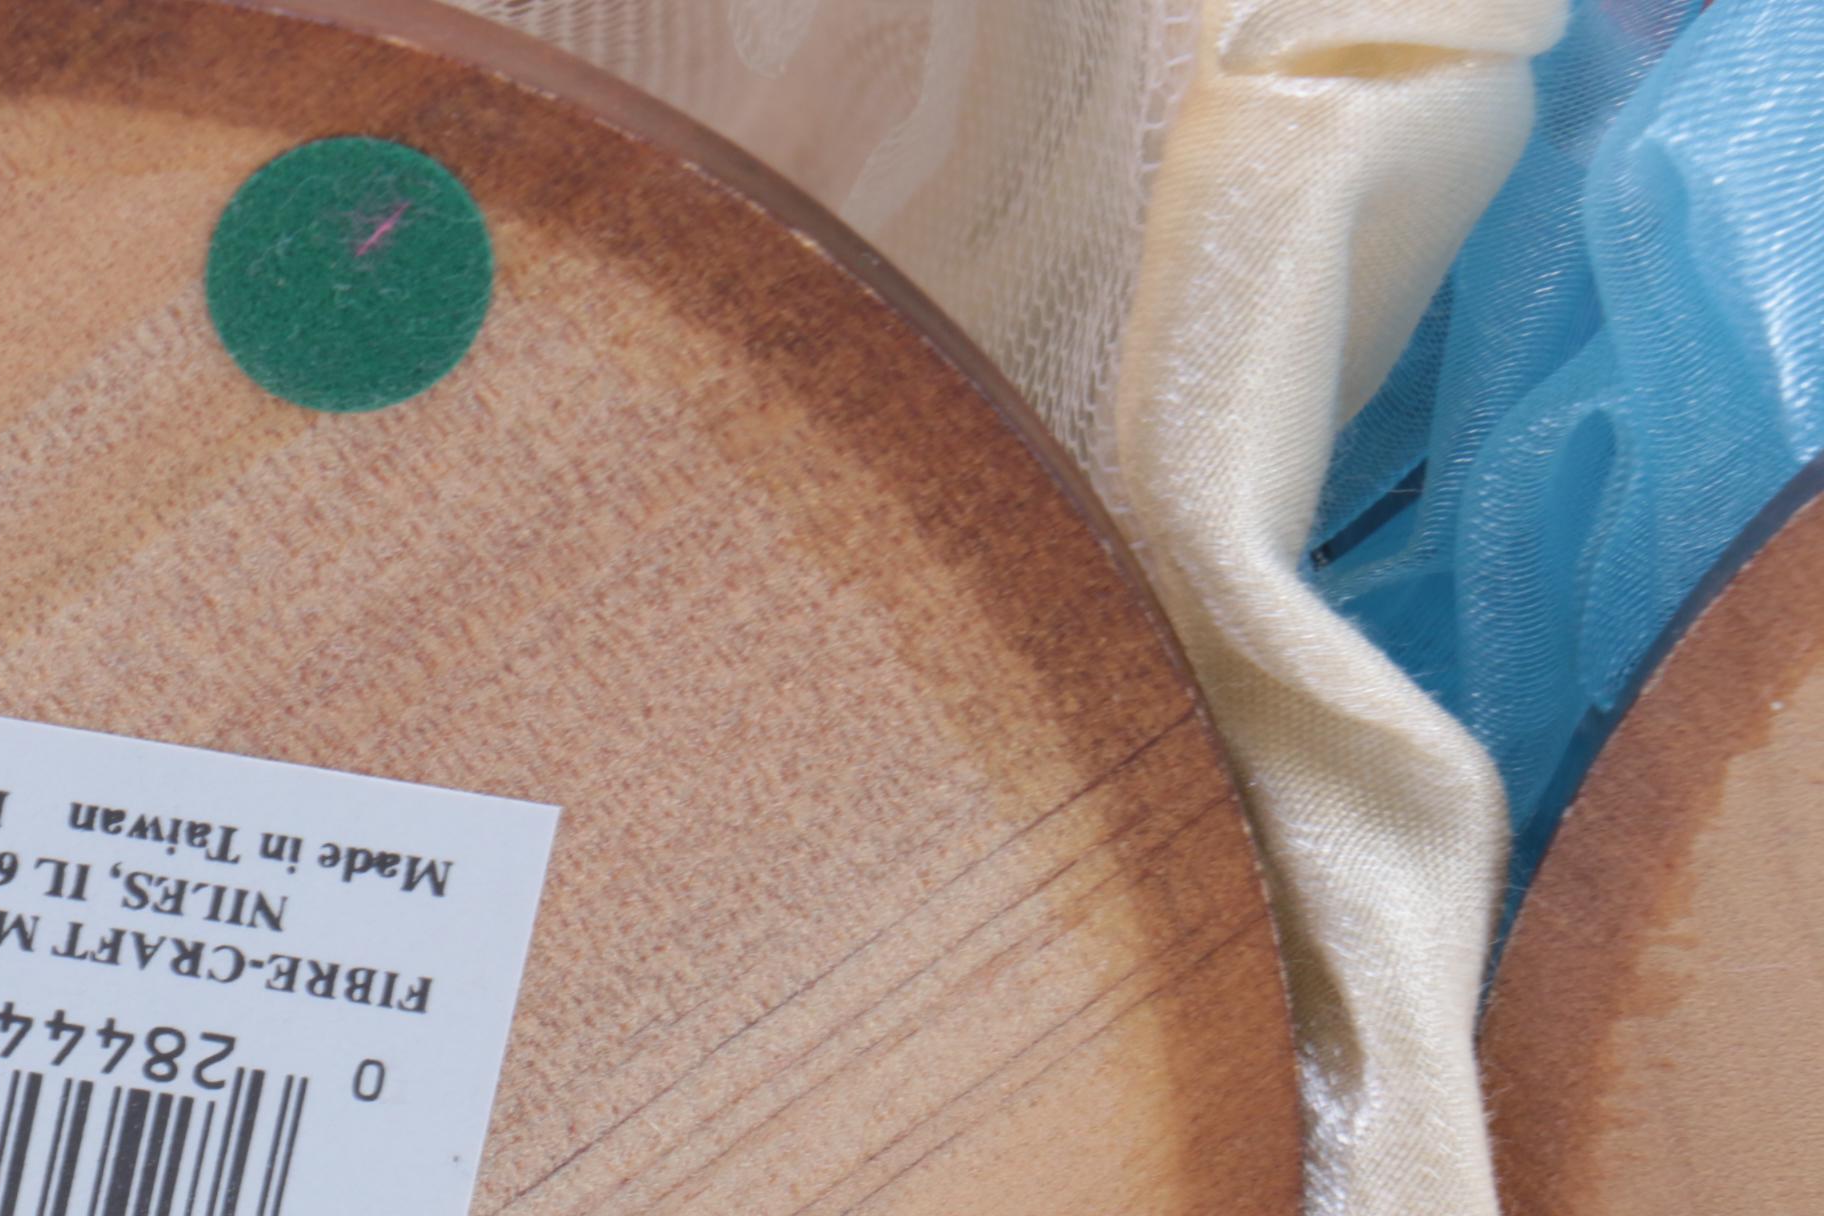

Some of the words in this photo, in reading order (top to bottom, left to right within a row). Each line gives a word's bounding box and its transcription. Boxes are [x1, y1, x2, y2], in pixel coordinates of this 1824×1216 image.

[66, 800, 241, 866] Taiwan
[257, 830, 304, 875] in
[33, 855, 92, 903] IL
[108, 860, 289, 933] NILES,
[315, 840, 454, 899] Made
[49, 919, 434, 1015] FIBRE-CRAFT
[350, 1056, 387, 1103] 0
